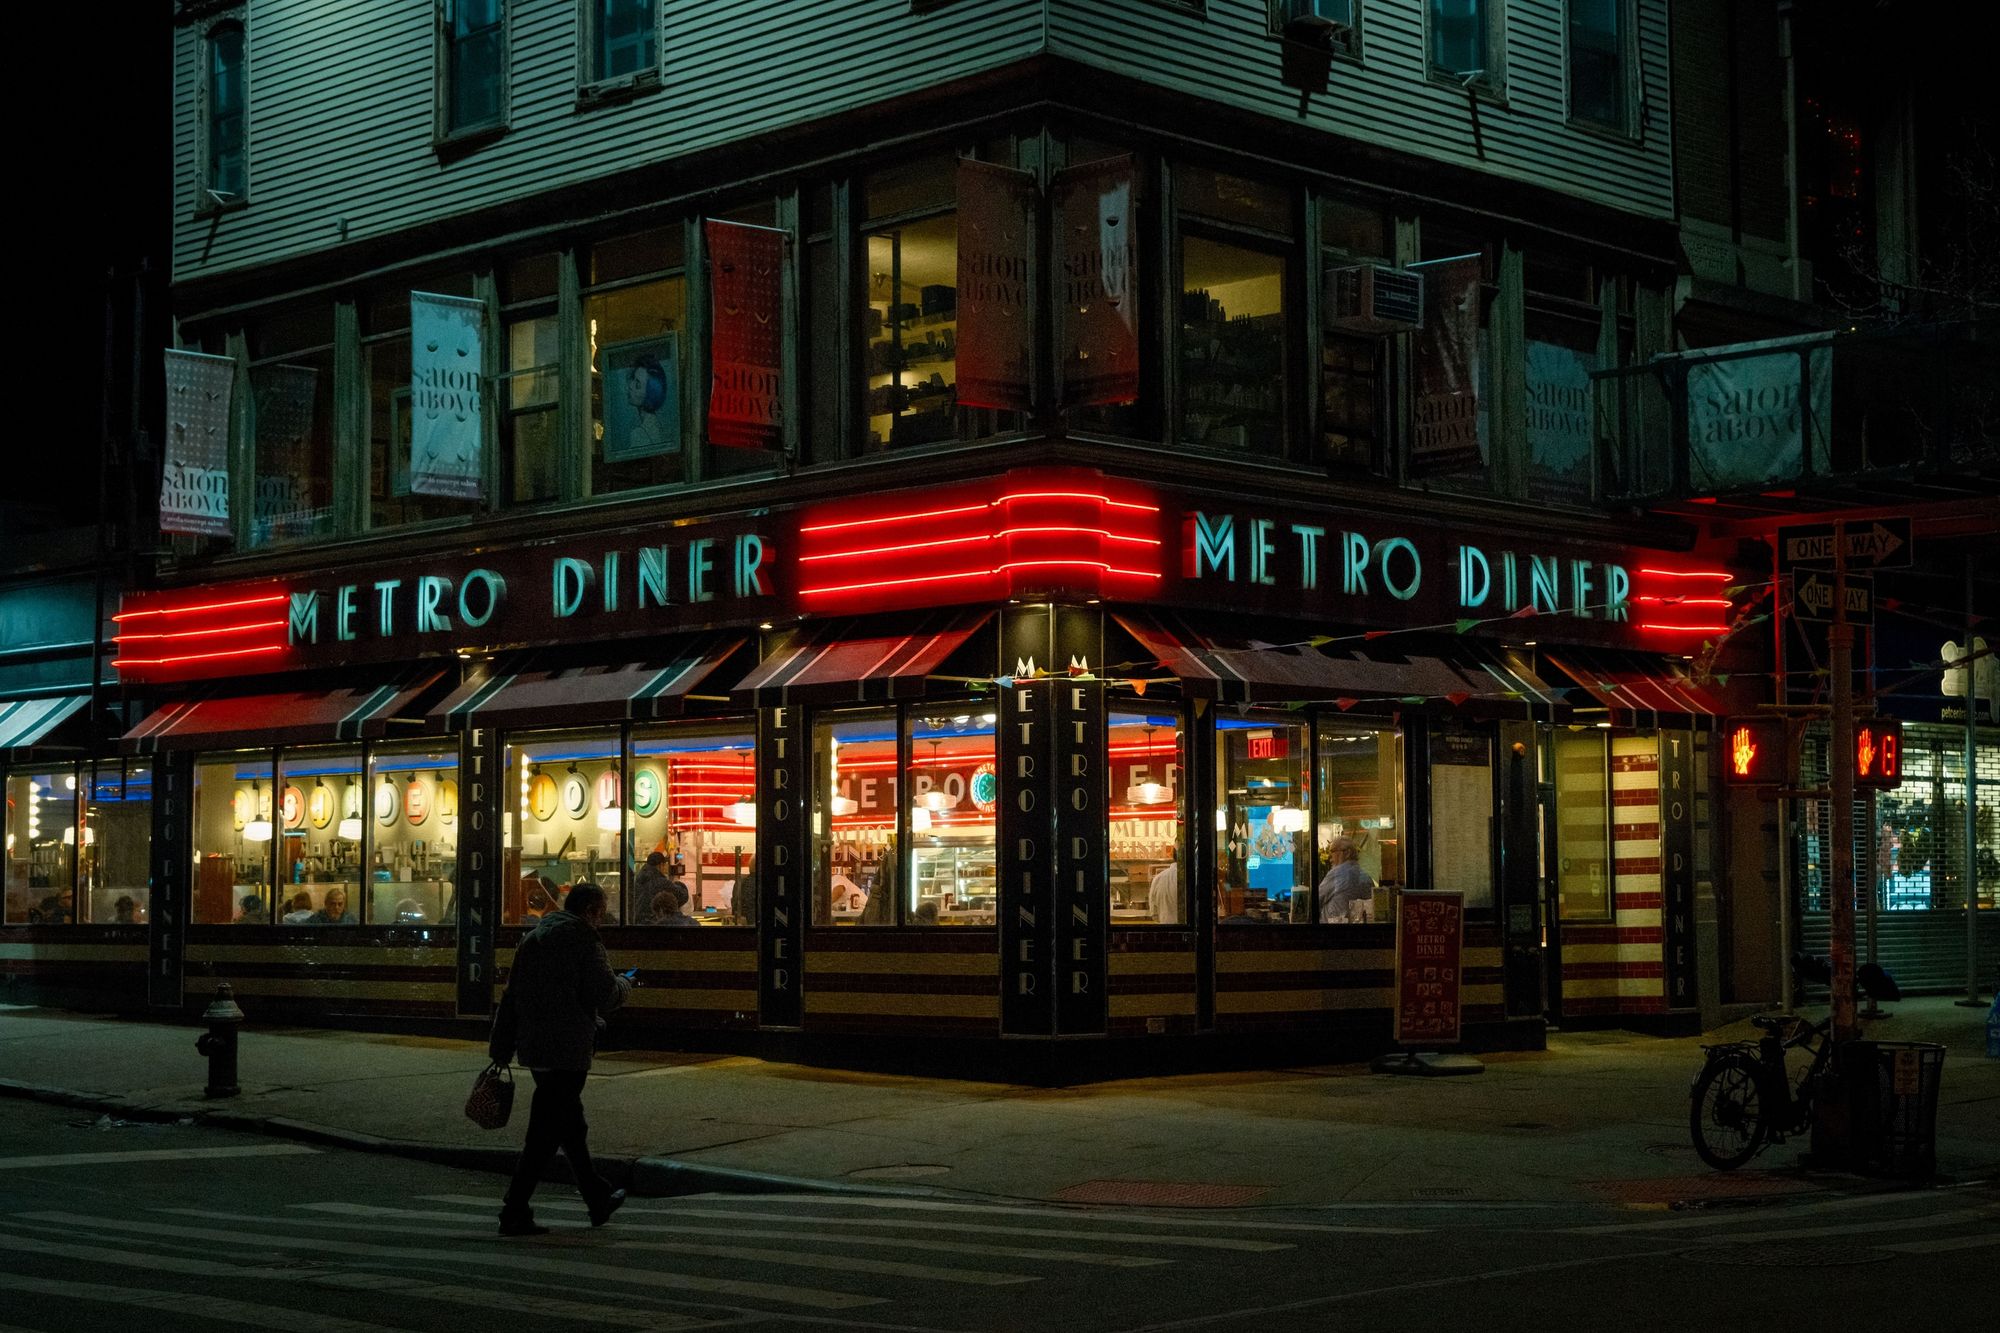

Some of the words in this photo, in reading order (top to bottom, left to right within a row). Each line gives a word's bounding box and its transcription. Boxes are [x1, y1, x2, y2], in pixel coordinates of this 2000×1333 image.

[164, 471, 227, 494] salon
[289, 569, 506, 646] METRO
[553, 534, 768, 618] DINER
[1192, 510, 1422, 600] METRO
[1458, 544, 1630, 623] DINER
[1797, 538, 1834, 557] ONE
[1851, 533, 1889, 554] WAY
[1806, 584, 1829, 606] ONE
[1843, 587, 1864, 609] AY
[471, 728, 485, 831] ETRO
[773, 707, 791, 820] ETRO
[1015, 655, 1037, 812] METRO
[1068, 654, 1089, 812] METRO
[1252, 738, 1272, 758] EXIT
[1671, 739, 1683, 820] TRO
[163, 749, 176, 841] ETRO
[469, 851, 484, 984] DINER
[773, 845, 790, 992] DINER
[1018, 837, 1037, 996] DINER
[1071, 837, 1090, 995] DINER
[1673, 853, 1685, 997] DINER
